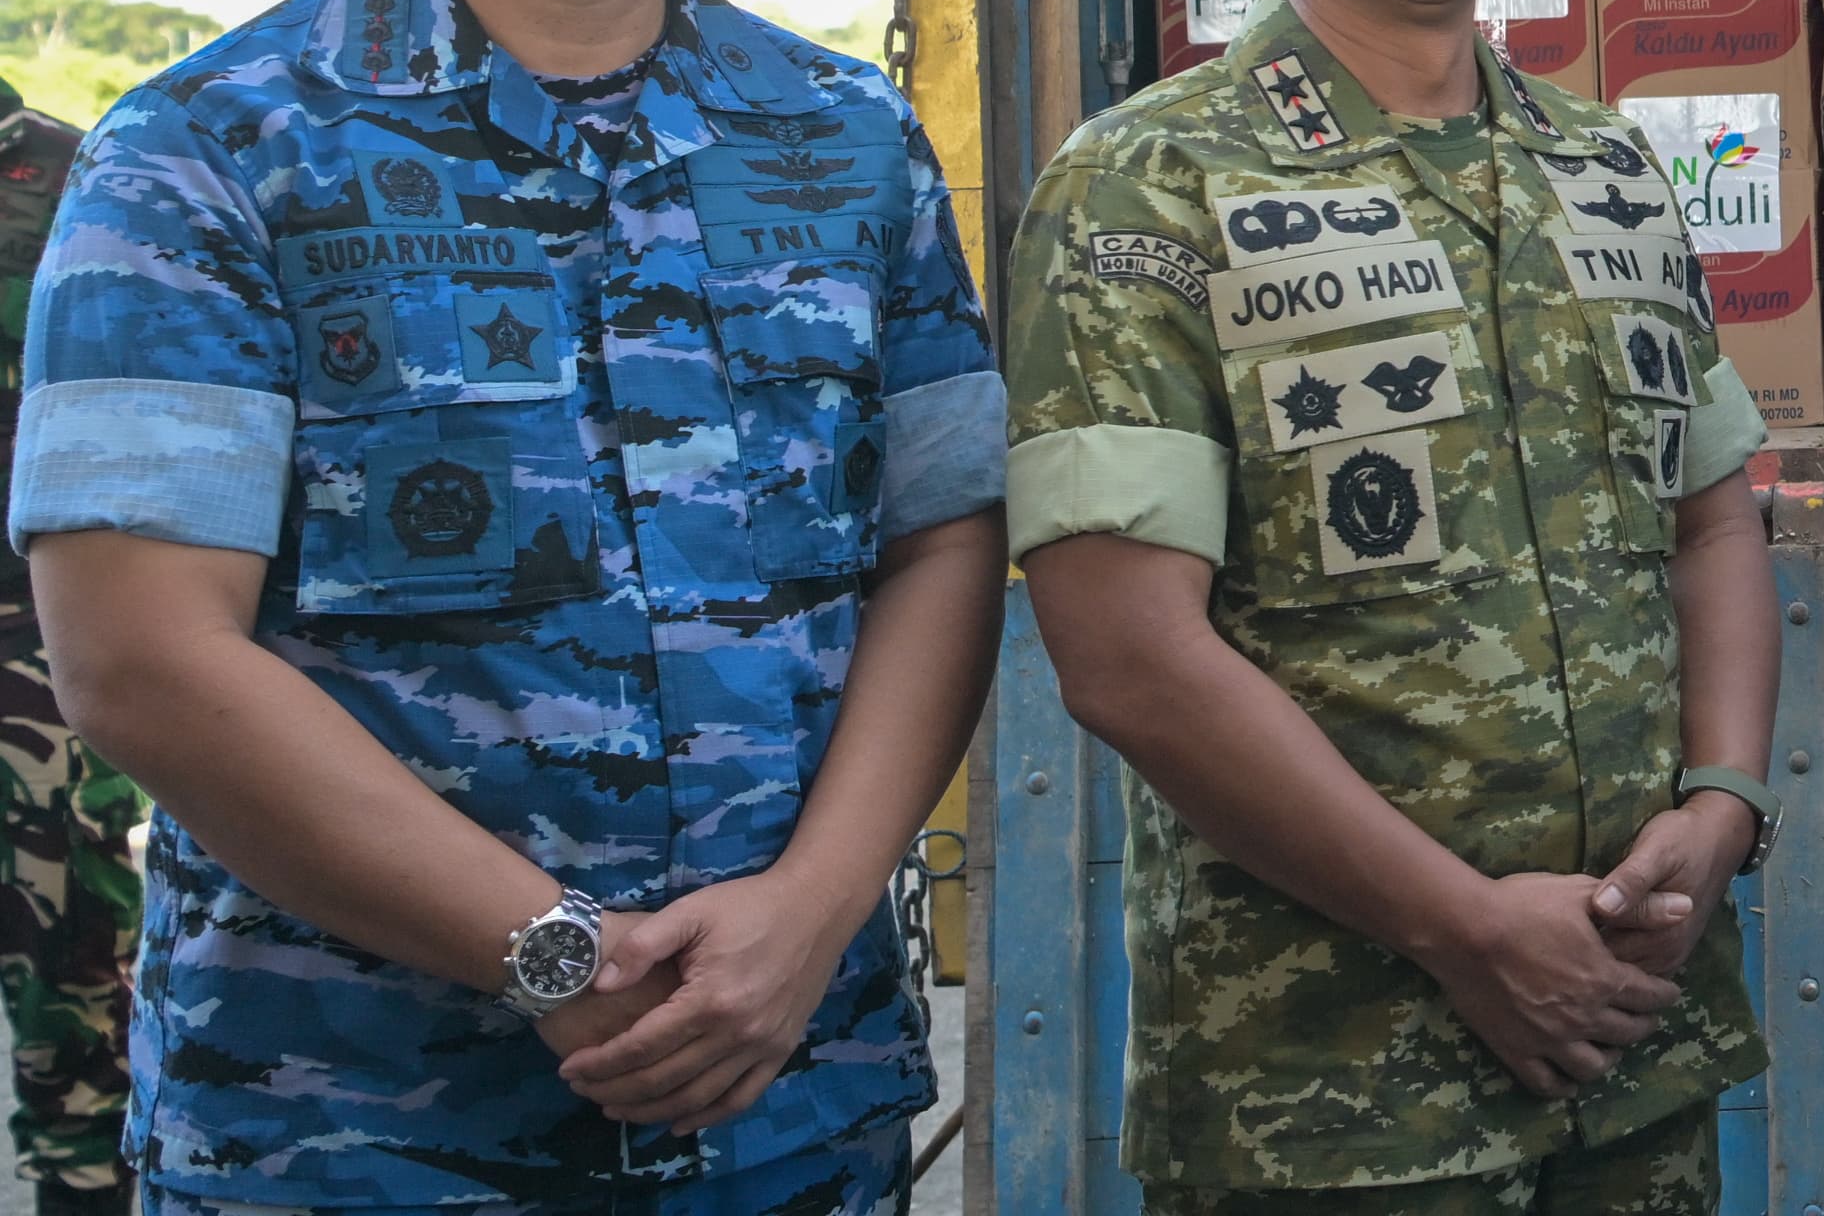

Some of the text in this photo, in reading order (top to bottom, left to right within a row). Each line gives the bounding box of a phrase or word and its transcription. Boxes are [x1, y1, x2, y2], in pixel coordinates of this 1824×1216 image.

[1644, 0, 1661, 12] Mi
[1513, 39, 1564, 68] yam
[1634, 31, 1778, 59] Kaldu Ayam
[1684, 183, 1770, 227] duli
[303, 229, 516, 276] SUDARYANTO
[741, 219, 894, 255] TNI AU
[1100, 257, 1206, 304] MOBIL UDARA
[1571, 248, 1684, 291] TNI AD
[1231, 257, 1444, 327] JOKO HADI
[1721, 288, 1791, 319] Ayam
[1763, 388, 1800, 402] RI MD
